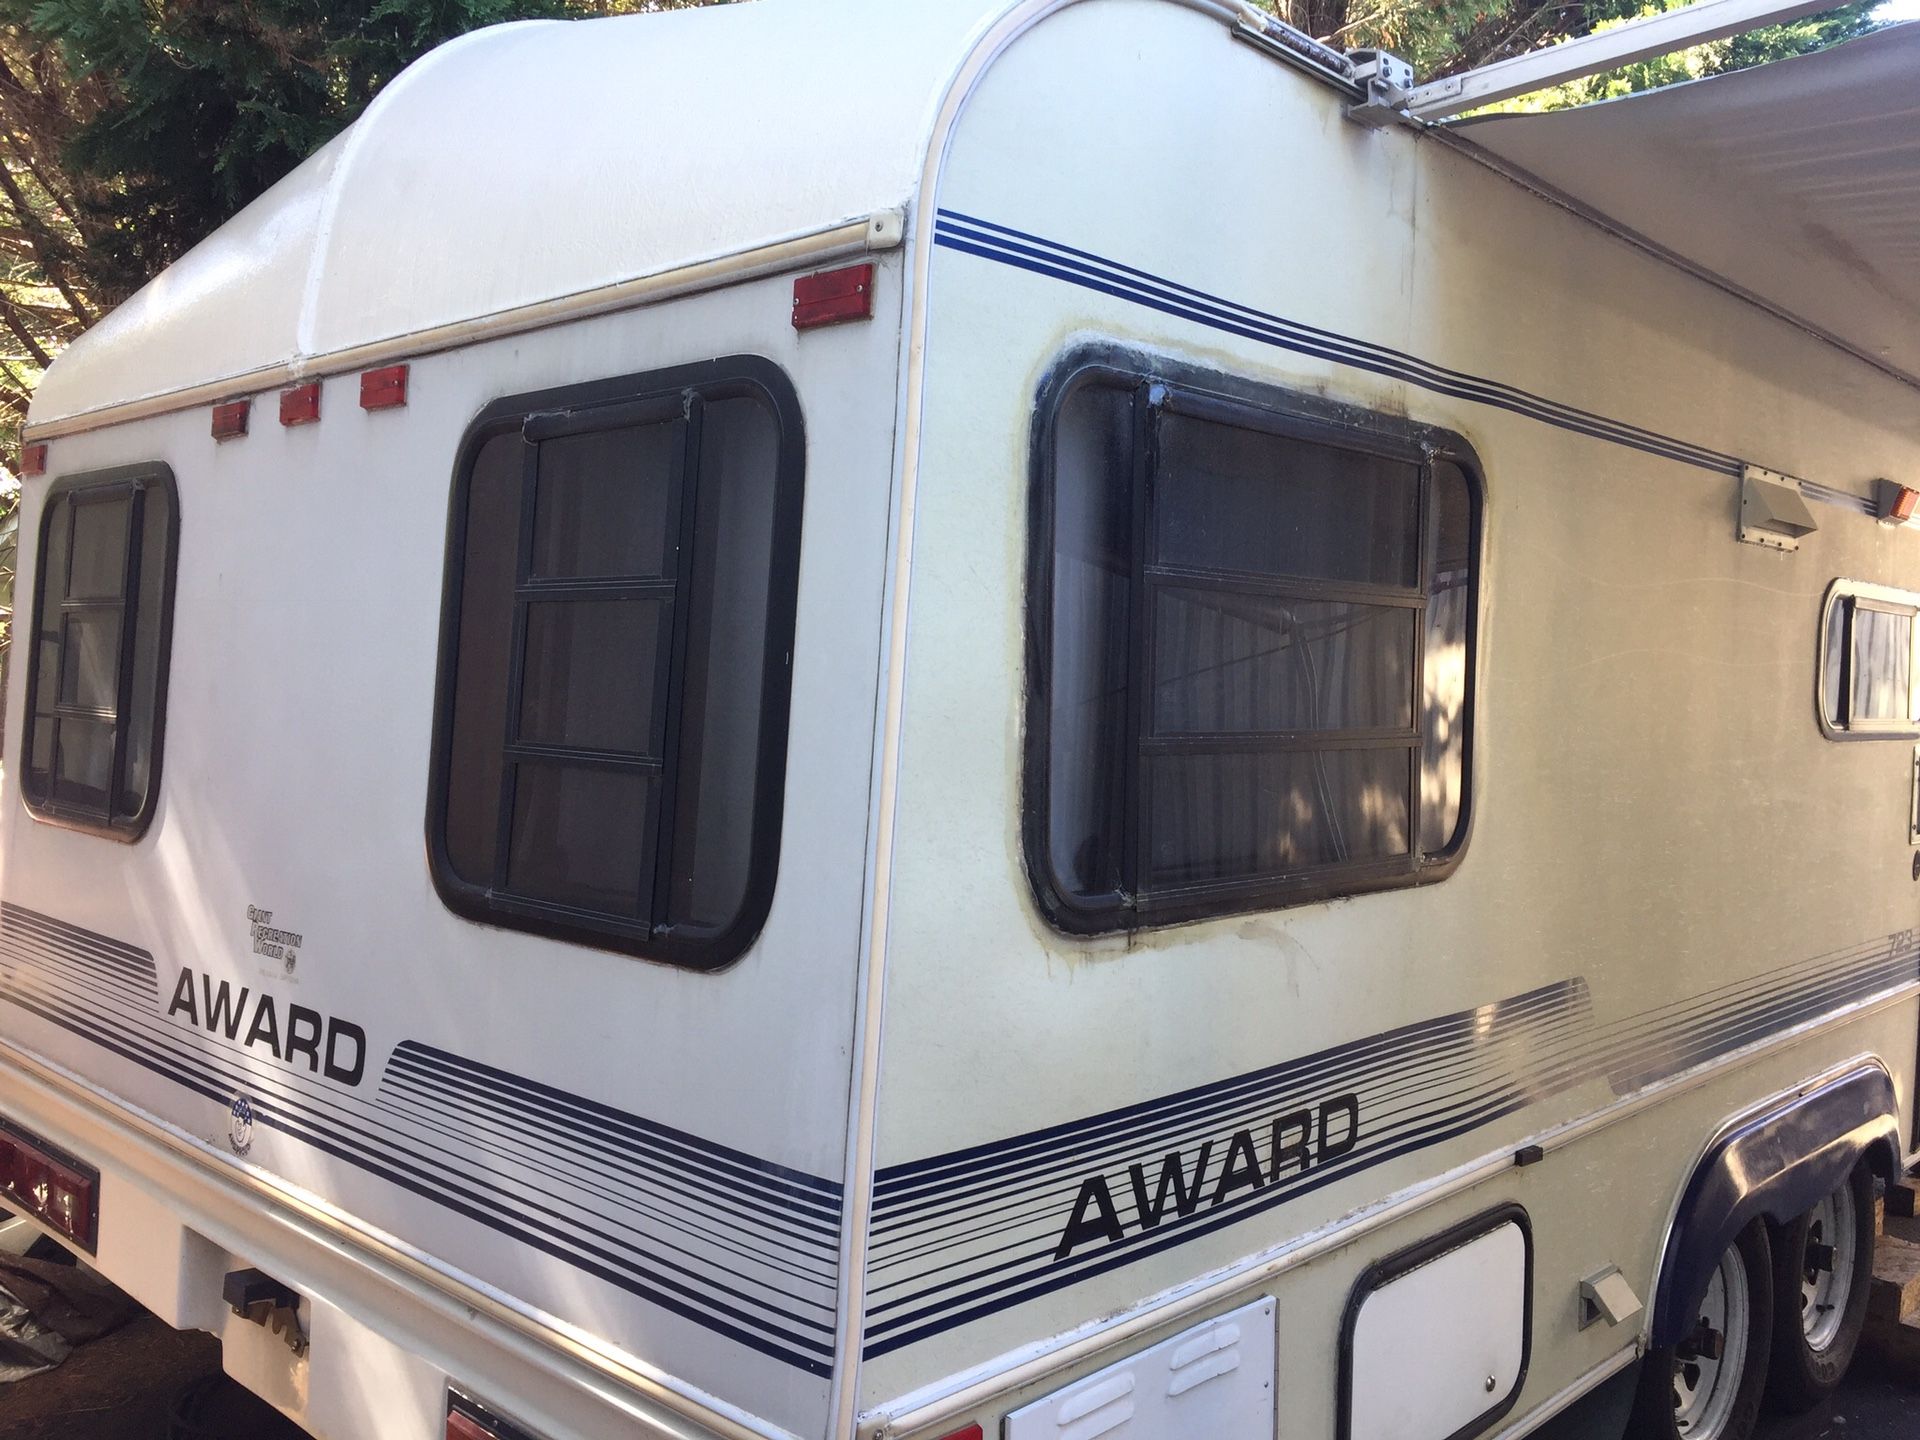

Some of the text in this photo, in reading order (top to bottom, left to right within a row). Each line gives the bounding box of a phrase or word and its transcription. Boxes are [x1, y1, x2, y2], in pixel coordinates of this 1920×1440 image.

[249, 920, 303, 948] RECREATION
[253, 936, 284, 960] WORLD
[167, 966, 367, 1087] AWARD
[1053, 1092, 1359, 1262] AWARD
